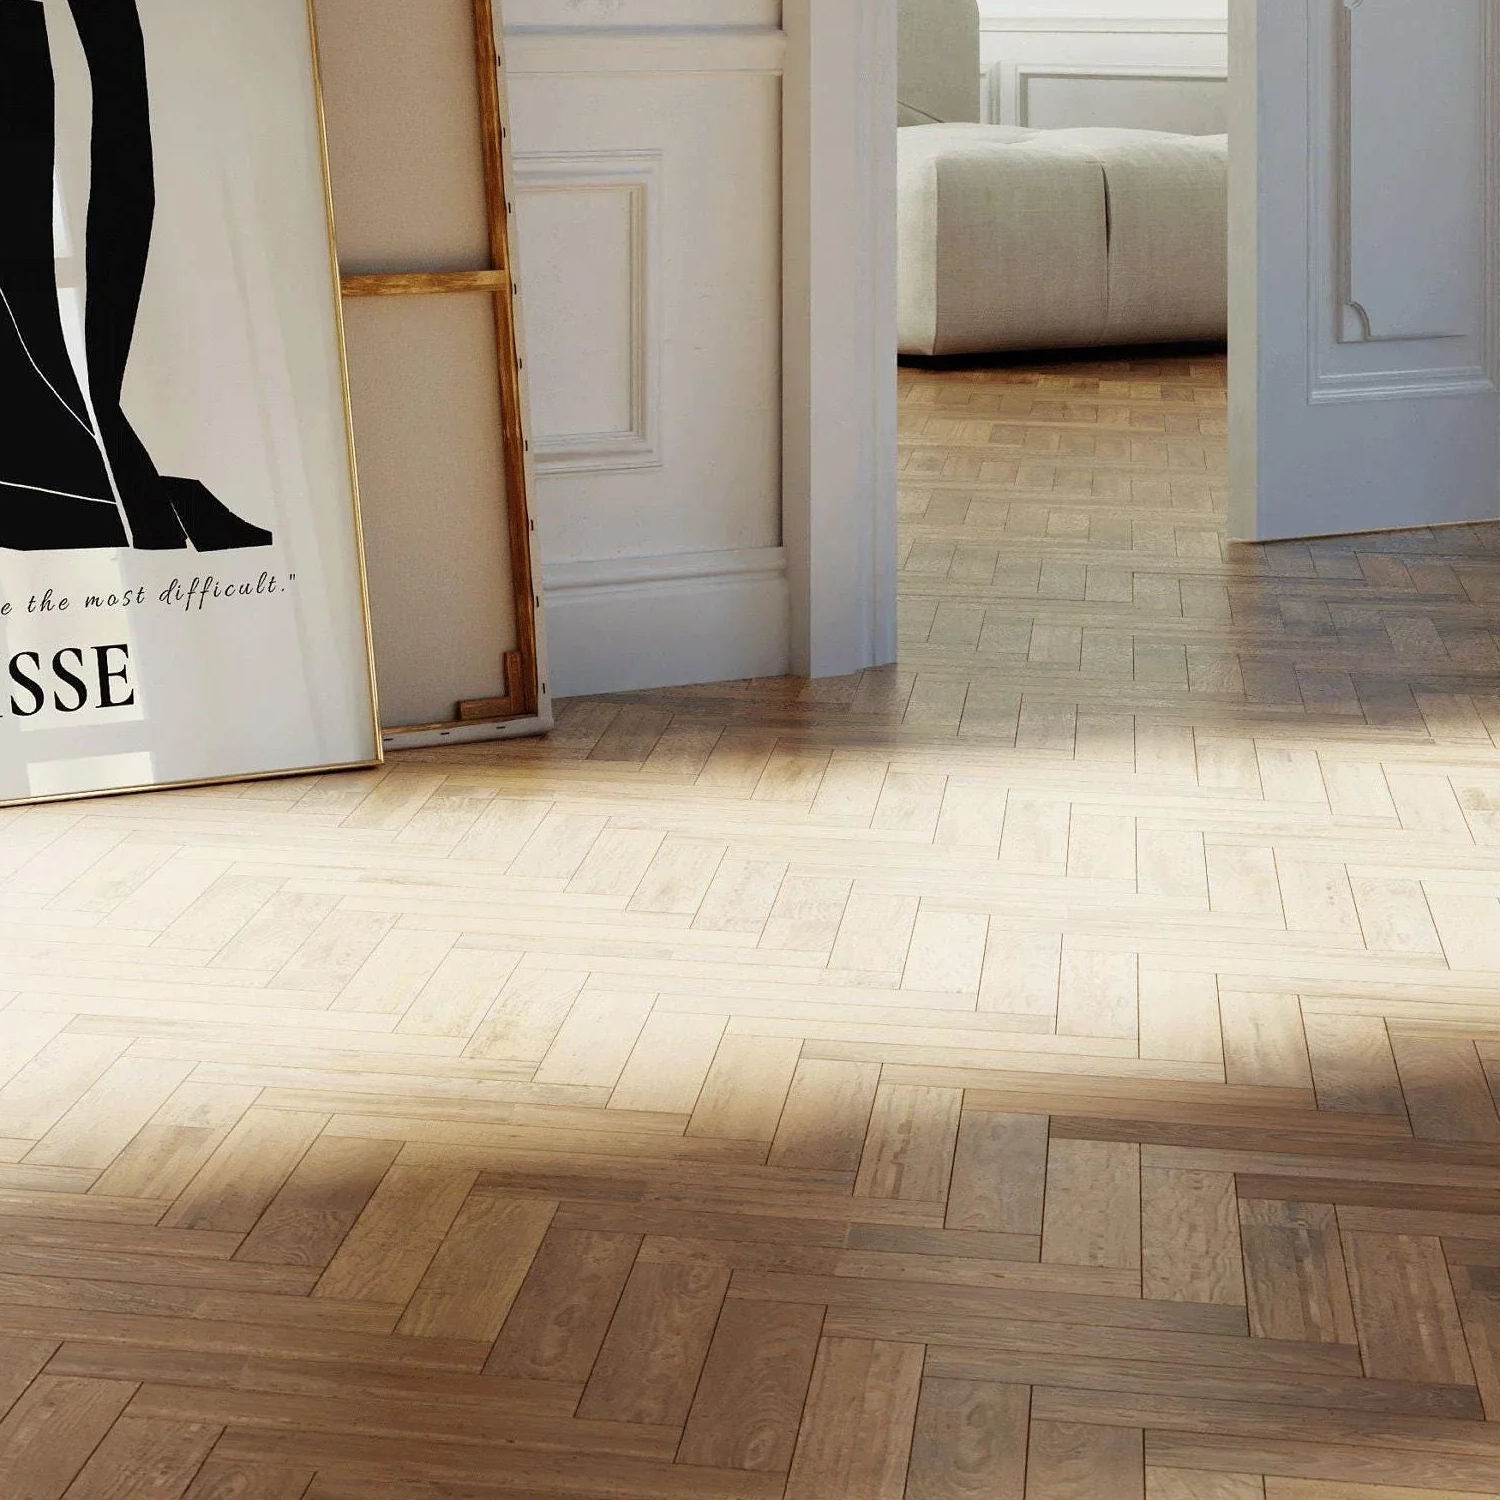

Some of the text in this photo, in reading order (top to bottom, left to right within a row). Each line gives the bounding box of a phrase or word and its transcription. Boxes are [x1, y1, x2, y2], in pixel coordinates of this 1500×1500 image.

[26, 588, 71, 614] the
[84, 585, 147, 609] most
[158, 571, 297, 612] difficult."
